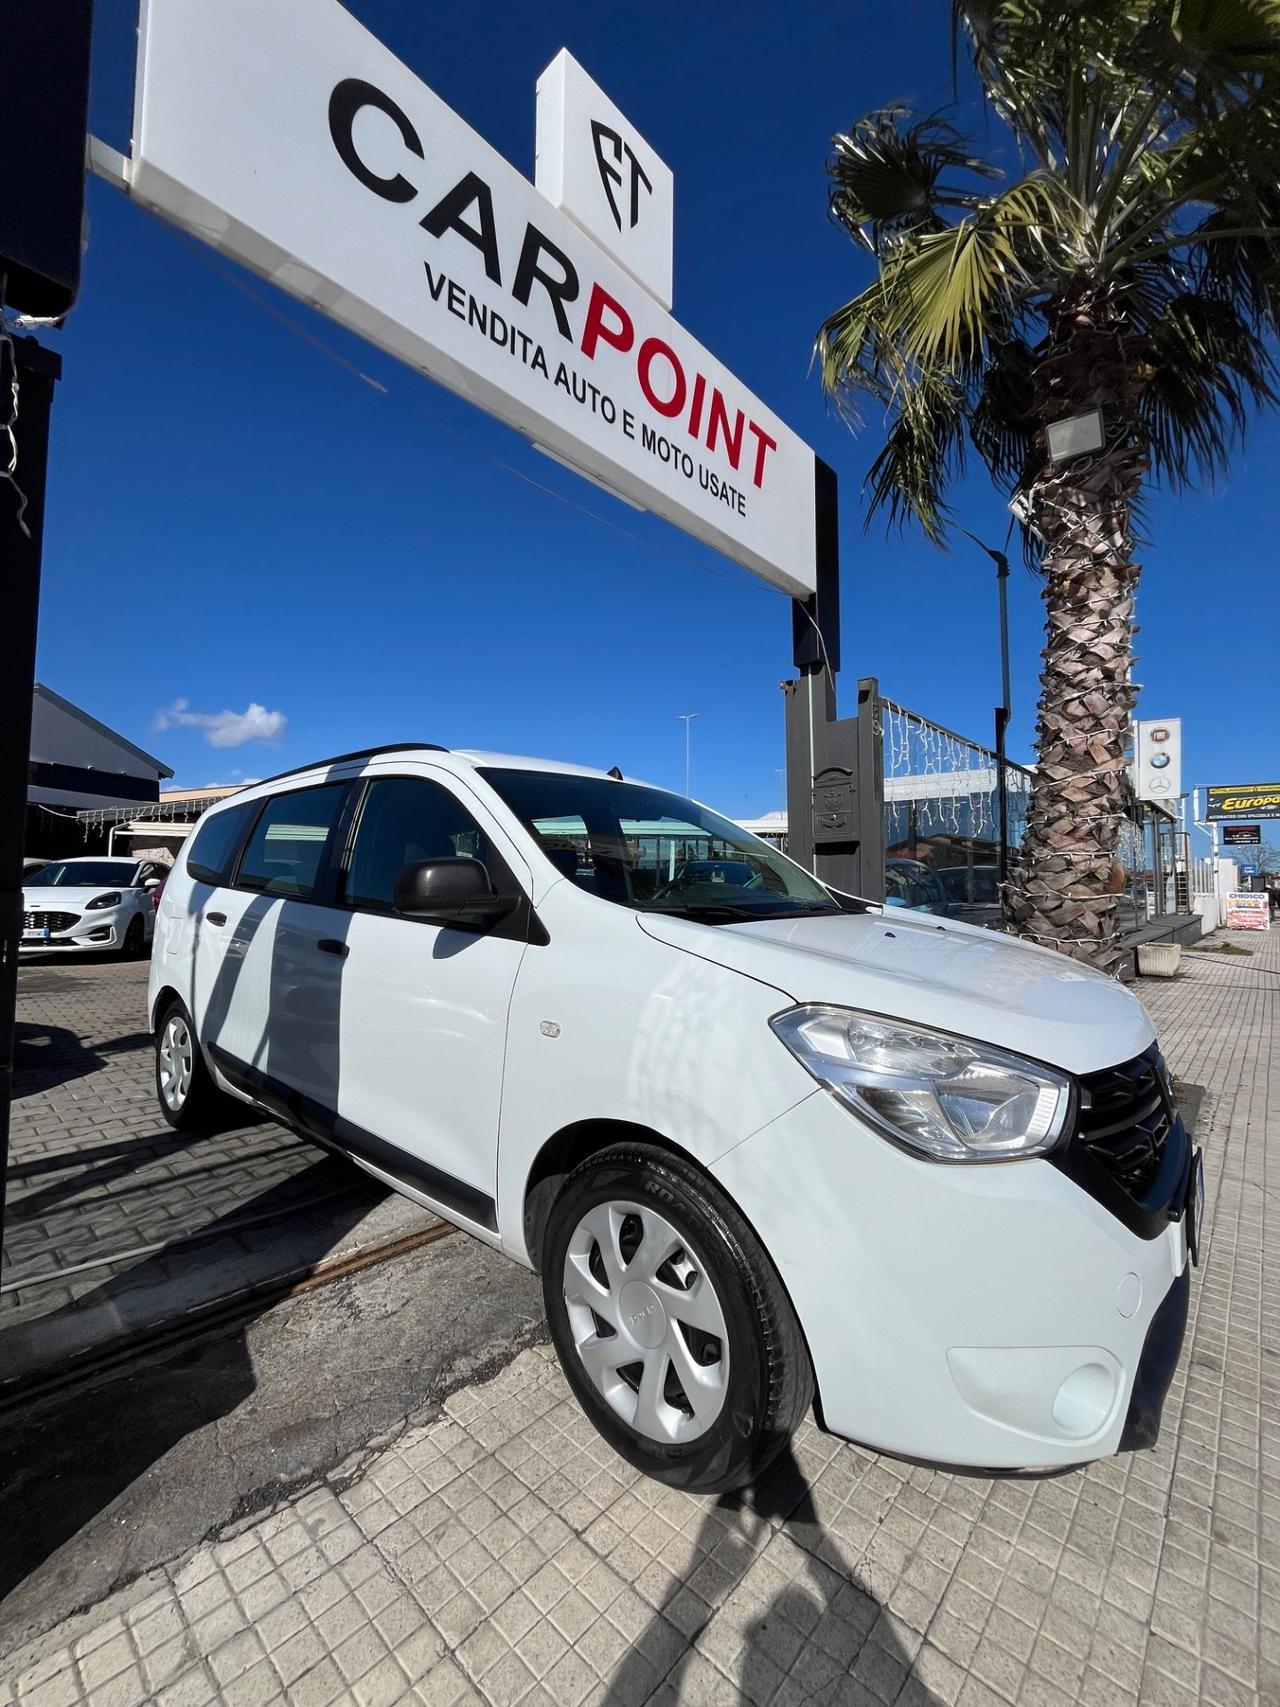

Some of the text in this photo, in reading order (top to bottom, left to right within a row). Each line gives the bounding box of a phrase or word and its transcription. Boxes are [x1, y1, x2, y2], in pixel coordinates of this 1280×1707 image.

[328, 78, 777, 489] CARPOINT
[424, 261, 746, 517] VENDITA AUTO E MOTO USATE
